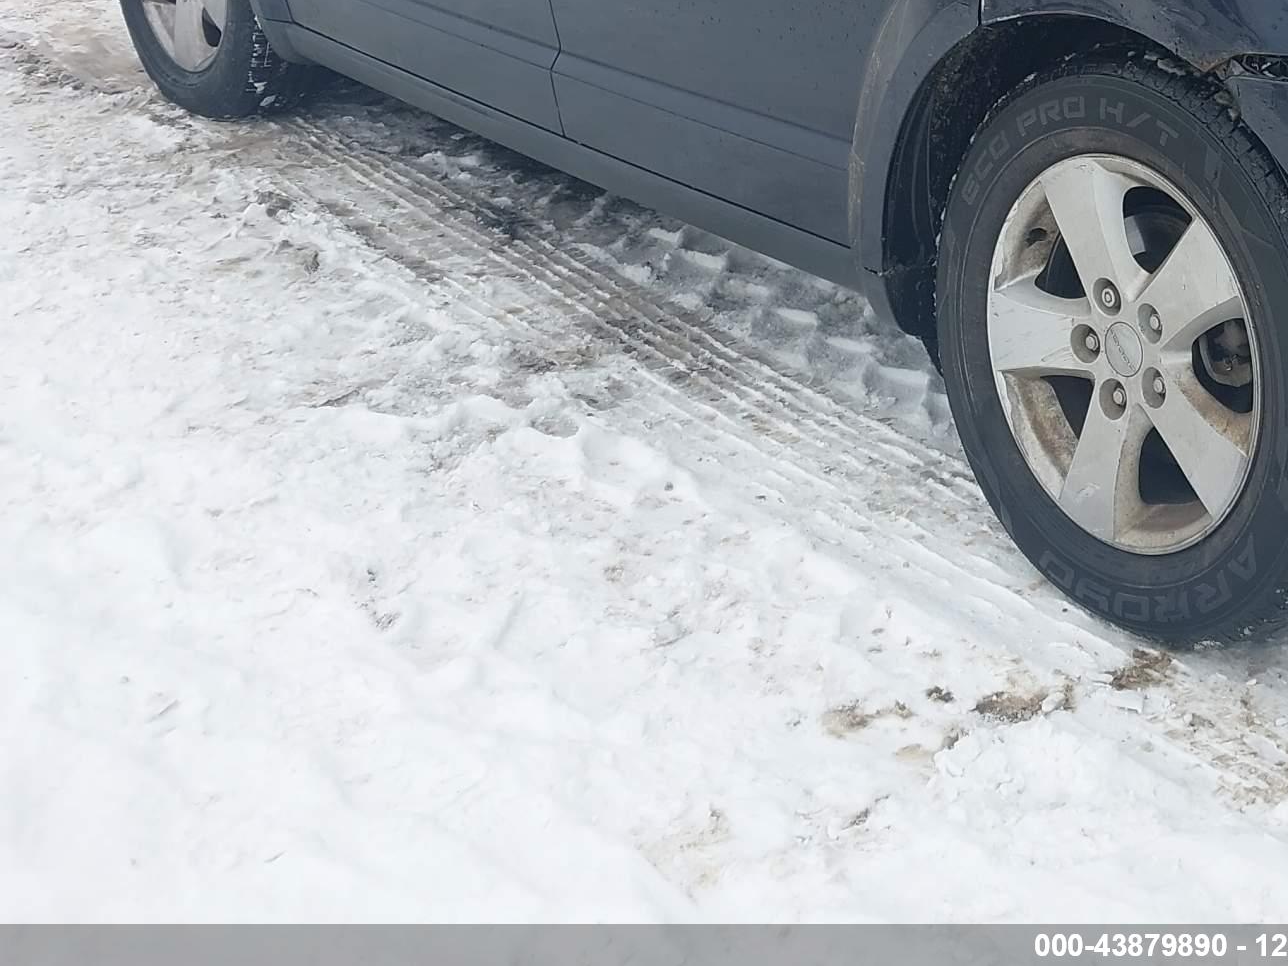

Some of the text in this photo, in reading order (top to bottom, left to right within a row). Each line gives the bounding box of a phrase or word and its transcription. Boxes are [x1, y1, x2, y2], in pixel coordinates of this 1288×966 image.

[960, 94, 1181, 206] ECO PRO H/T
[1037, 531, 1258, 624] ARROYO
